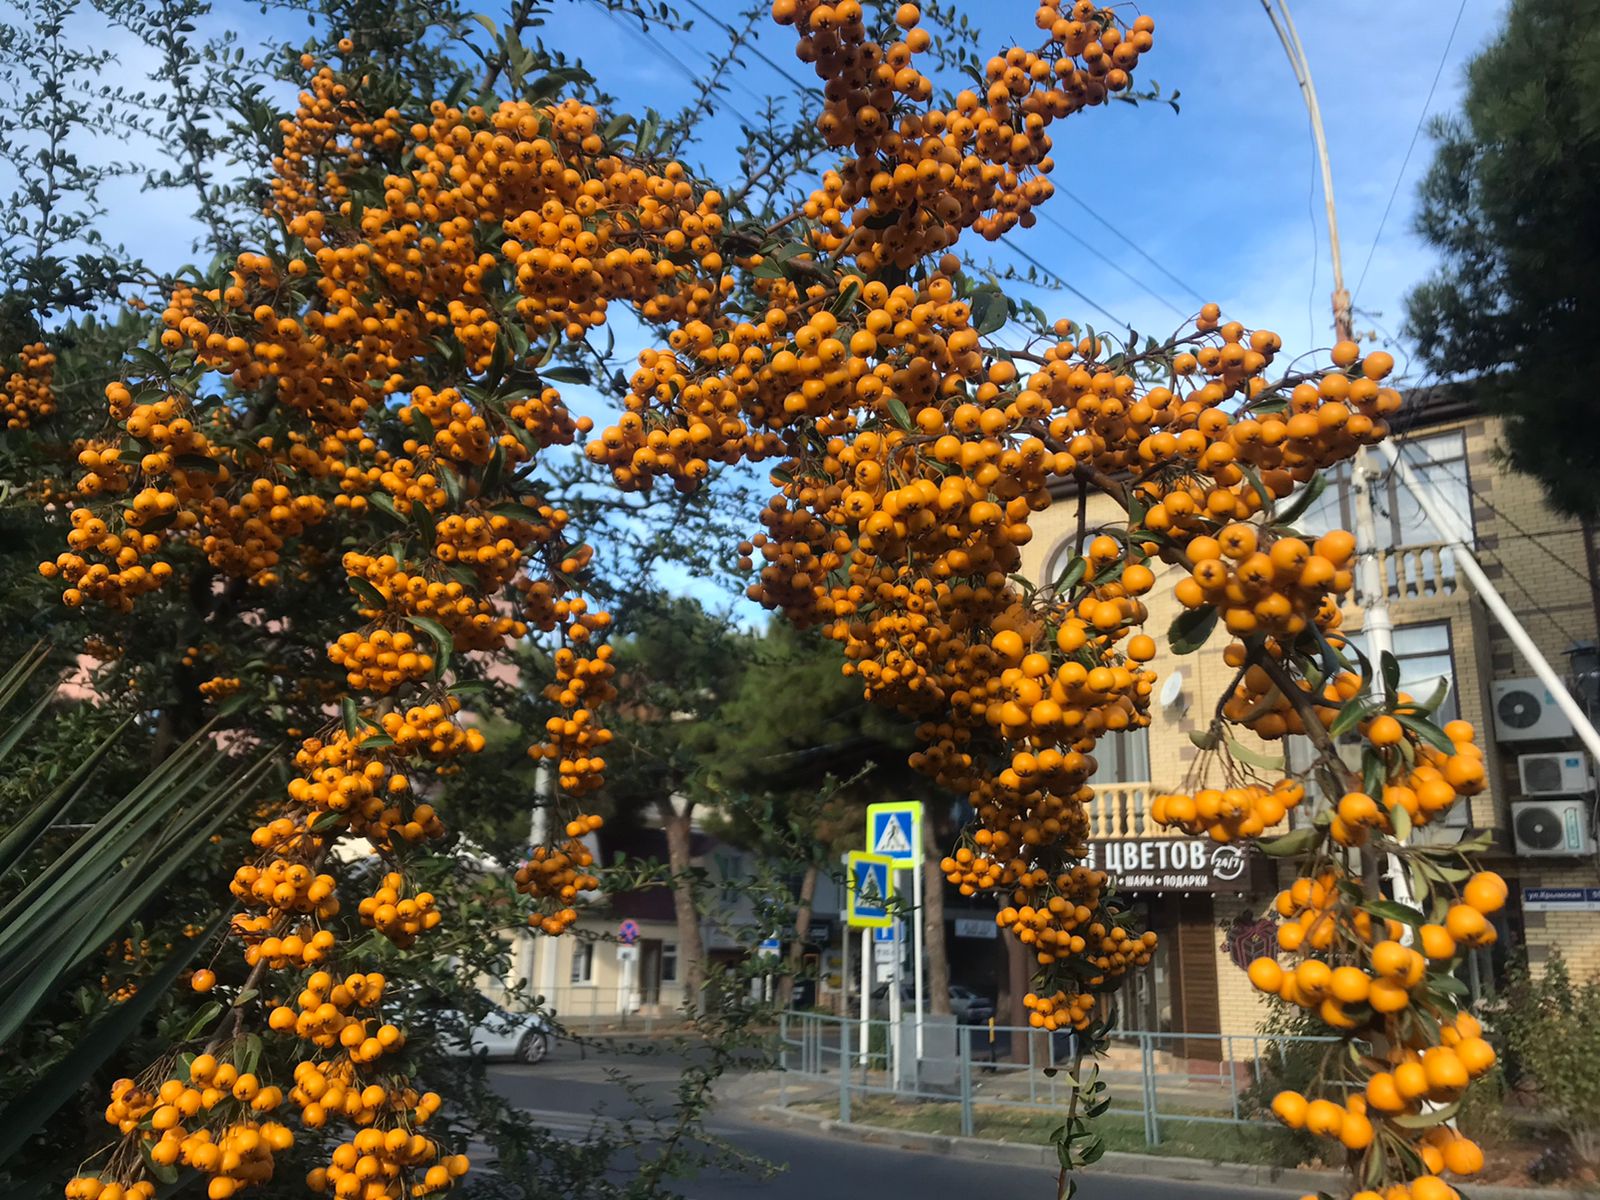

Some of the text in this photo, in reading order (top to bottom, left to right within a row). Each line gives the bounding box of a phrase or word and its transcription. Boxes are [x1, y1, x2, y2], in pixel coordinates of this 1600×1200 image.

[1105, 841, 1206, 874] ЦВЕТОВ
[1214, 857, 1239, 869] 24/7
[1125, 875, 1153, 887] ШАРЫ
[1163, 875, 1208, 887] ПОДАРКИ
